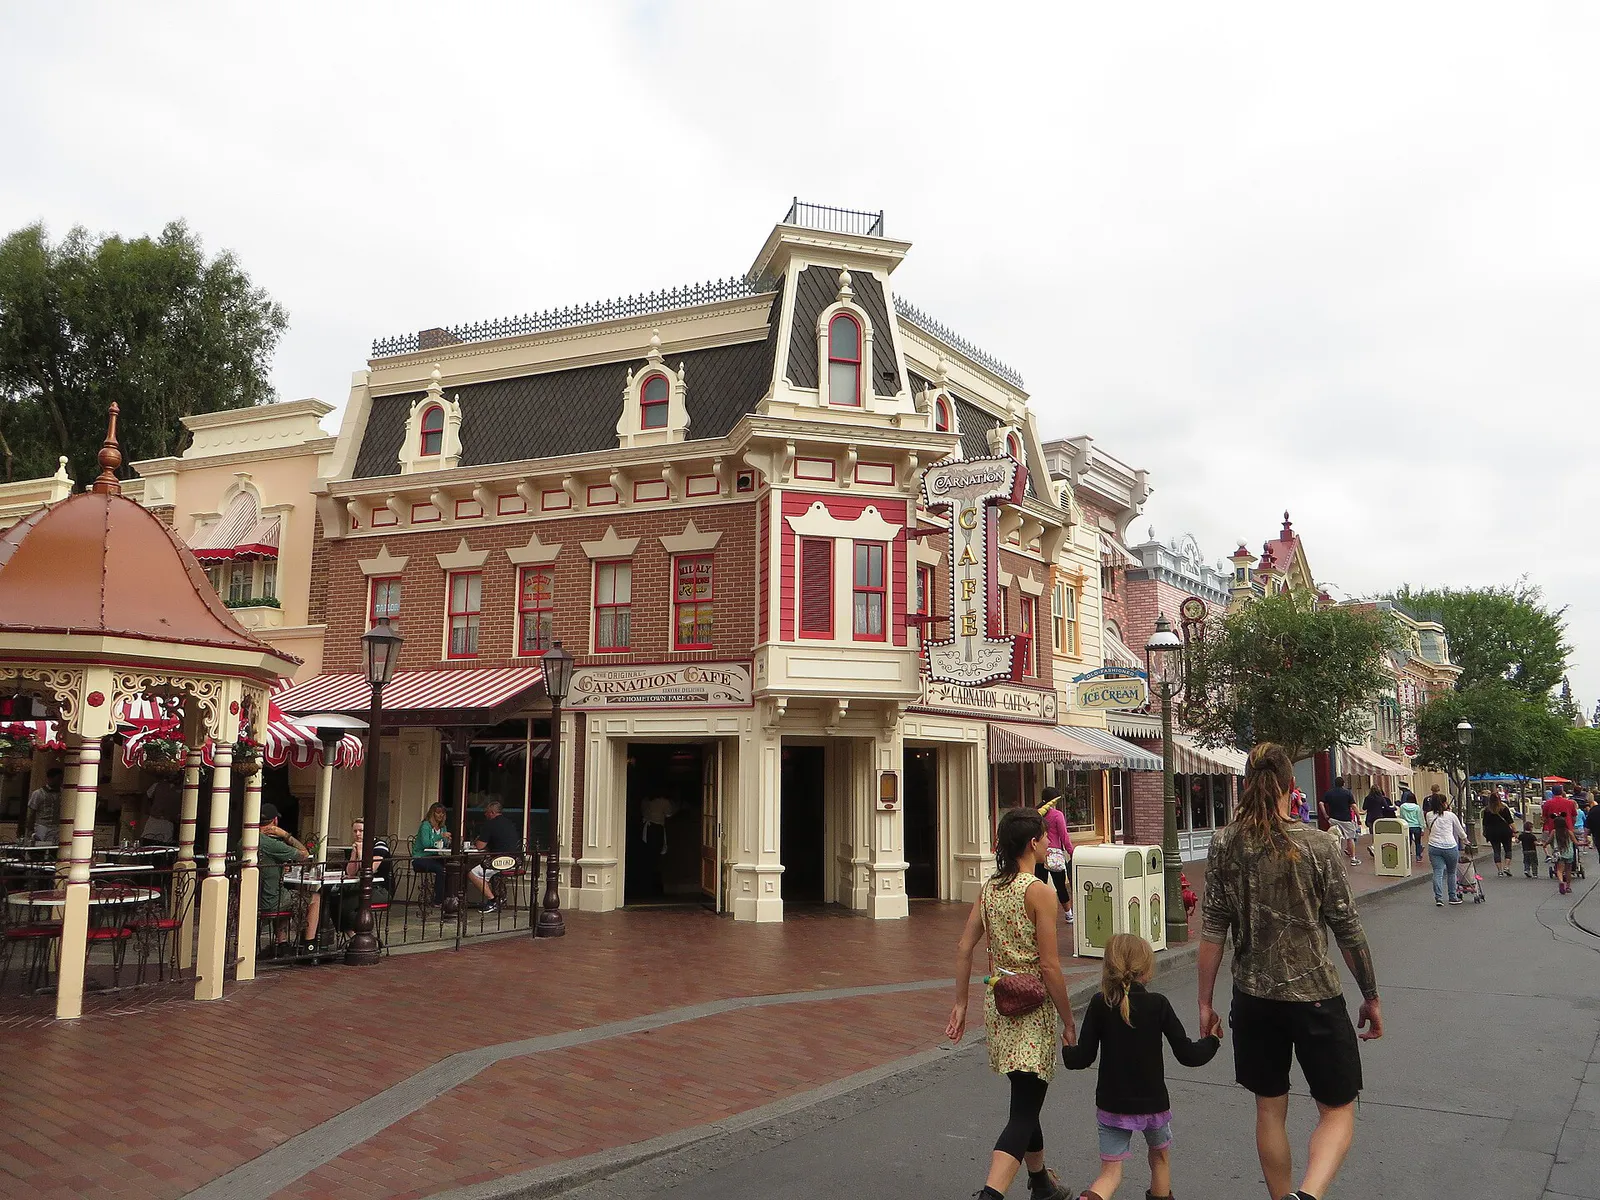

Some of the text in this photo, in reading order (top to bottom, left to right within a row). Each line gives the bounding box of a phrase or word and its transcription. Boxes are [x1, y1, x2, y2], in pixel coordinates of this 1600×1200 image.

[932, 471, 1006, 495] CARNATION
[958, 506, 979, 637] CAFÉ
[579, 672, 678, 692] CARNATION
[607, 671, 643, 680] ORIGINAL
[625, 694, 667, 702] HOMETOWN
[951, 686, 997, 708] CARNATION
[1083, 689, 1140, 706] ICE CREAM
